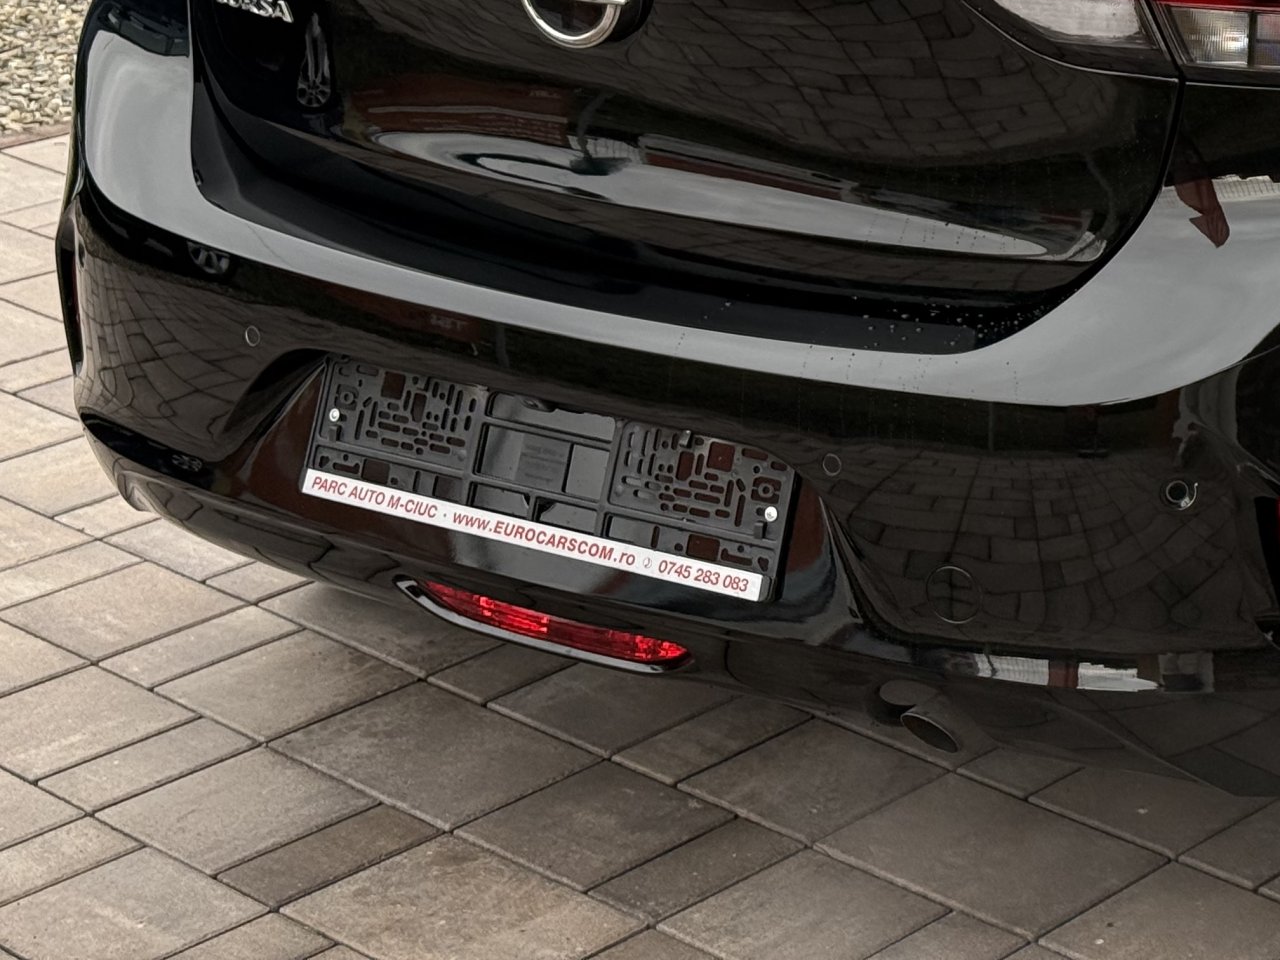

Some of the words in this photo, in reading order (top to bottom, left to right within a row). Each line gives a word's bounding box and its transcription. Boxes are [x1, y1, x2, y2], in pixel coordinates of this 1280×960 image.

[311, 475, 348, 496] PARC
[348, 485, 386, 506] AUTO
[387, 494, 439, 519] M-CIUC
[657, 559, 692, 579] 0745
[693, 567, 721, 586] 283
[722, 574, 750, 593] 083
